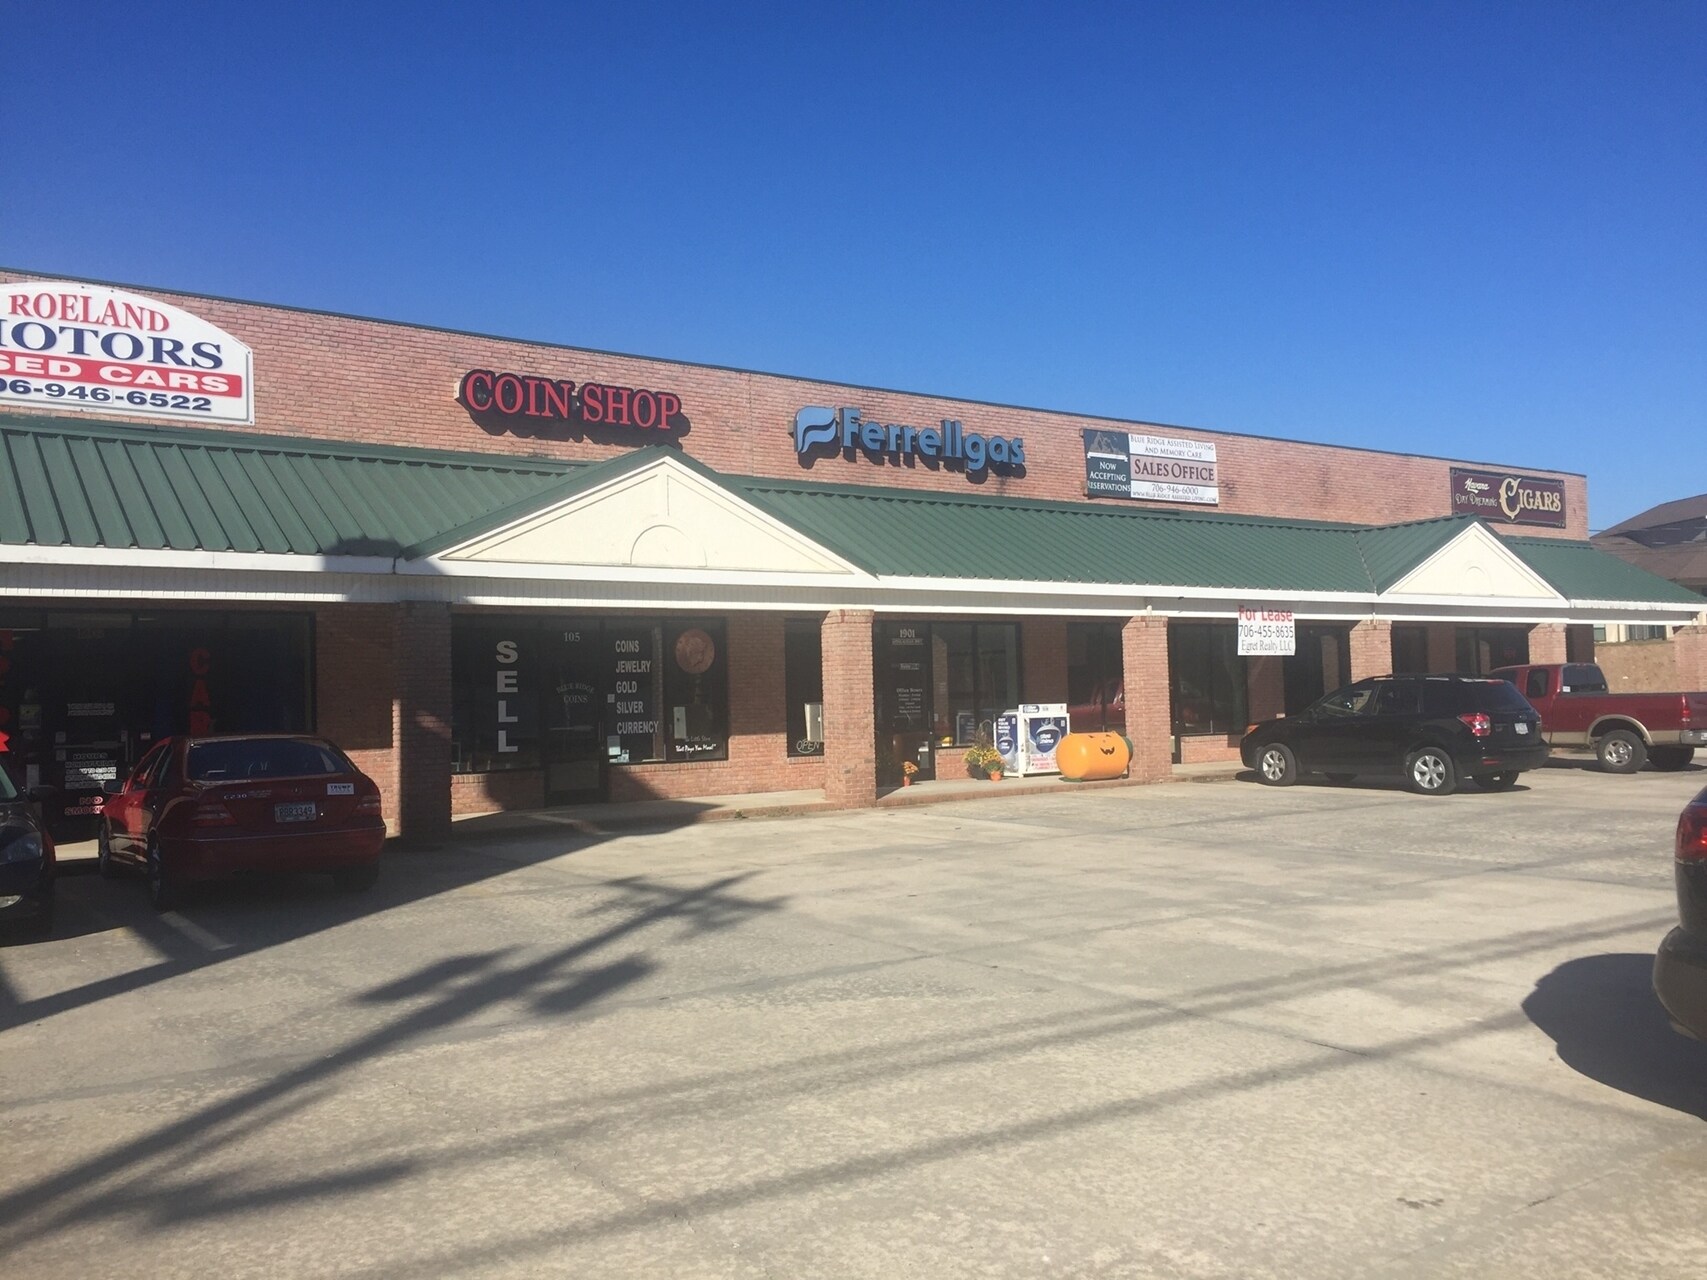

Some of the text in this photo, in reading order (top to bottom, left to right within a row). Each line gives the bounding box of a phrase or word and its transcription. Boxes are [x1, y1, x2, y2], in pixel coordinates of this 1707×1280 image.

[8, 292, 169, 332] ROELAND
[99, 366, 230, 393] CARS
[465, 372, 679, 430] COIN SHOP
[839, 406, 1026, 471] Ferrellgas
[1130, 435, 1214, 451] BLUE RIDGE ASSISTED LIVING
[1145, 446, 1158, 454] AND
[1160, 448, 1185, 457] MEMORY
[1099, 461, 1117, 470] NOW
[1134, 458, 1215, 482] SALES OFFICE
[1089, 471, 1127, 482] ACCEPTING
[1151, 484, 1199, 495] 706-946-6000
[1499, 477, 1562, 520] CIGARS
[1238, 604, 1293, 622] For Lease
[563, 631, 581, 642] 105
[899, 628, 915, 638] 1901
[1238, 624, 1294, 639] 706-455-8635
[615, 640, 639, 652] COINS
[1259, 639, 1278, 653] Realty
[1279, 640, 1293, 651] LLC
[615, 660, 651, 673] JEWELRY
[615, 681, 637, 694] GOLD
[563, 695, 588, 704] COINS
[616, 701, 644, 714] SILVER
[616, 721, 659, 734] CURRENCY
[796, 739, 820, 751] OPEN
[80, 796, 103, 805] NO
